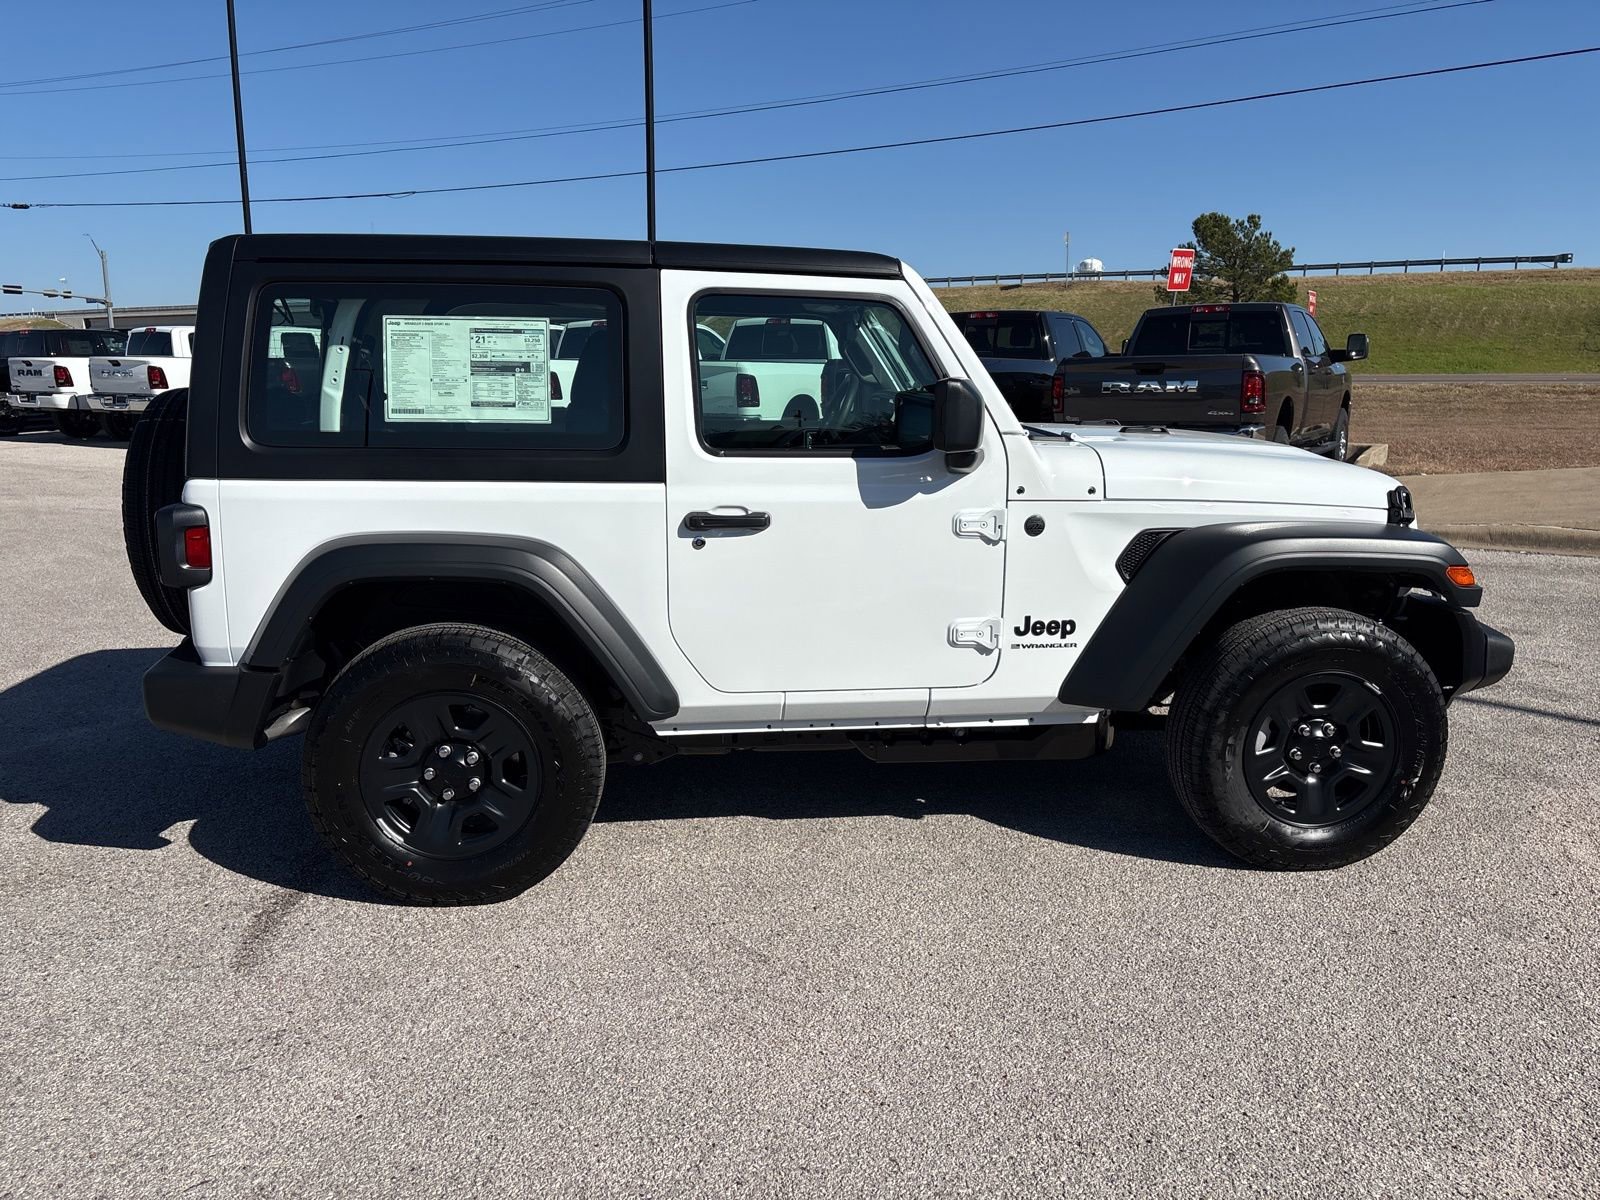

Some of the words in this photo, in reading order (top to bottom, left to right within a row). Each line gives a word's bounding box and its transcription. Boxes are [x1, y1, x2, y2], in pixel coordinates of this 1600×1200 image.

[1172, 256, 1192, 268] WRONG
[1173, 273, 1186, 284] WAY
[475, 335, 486, 344] 21
[1102, 380, 1198, 394] RAM
[1014, 615, 1076, 639] Jeep
